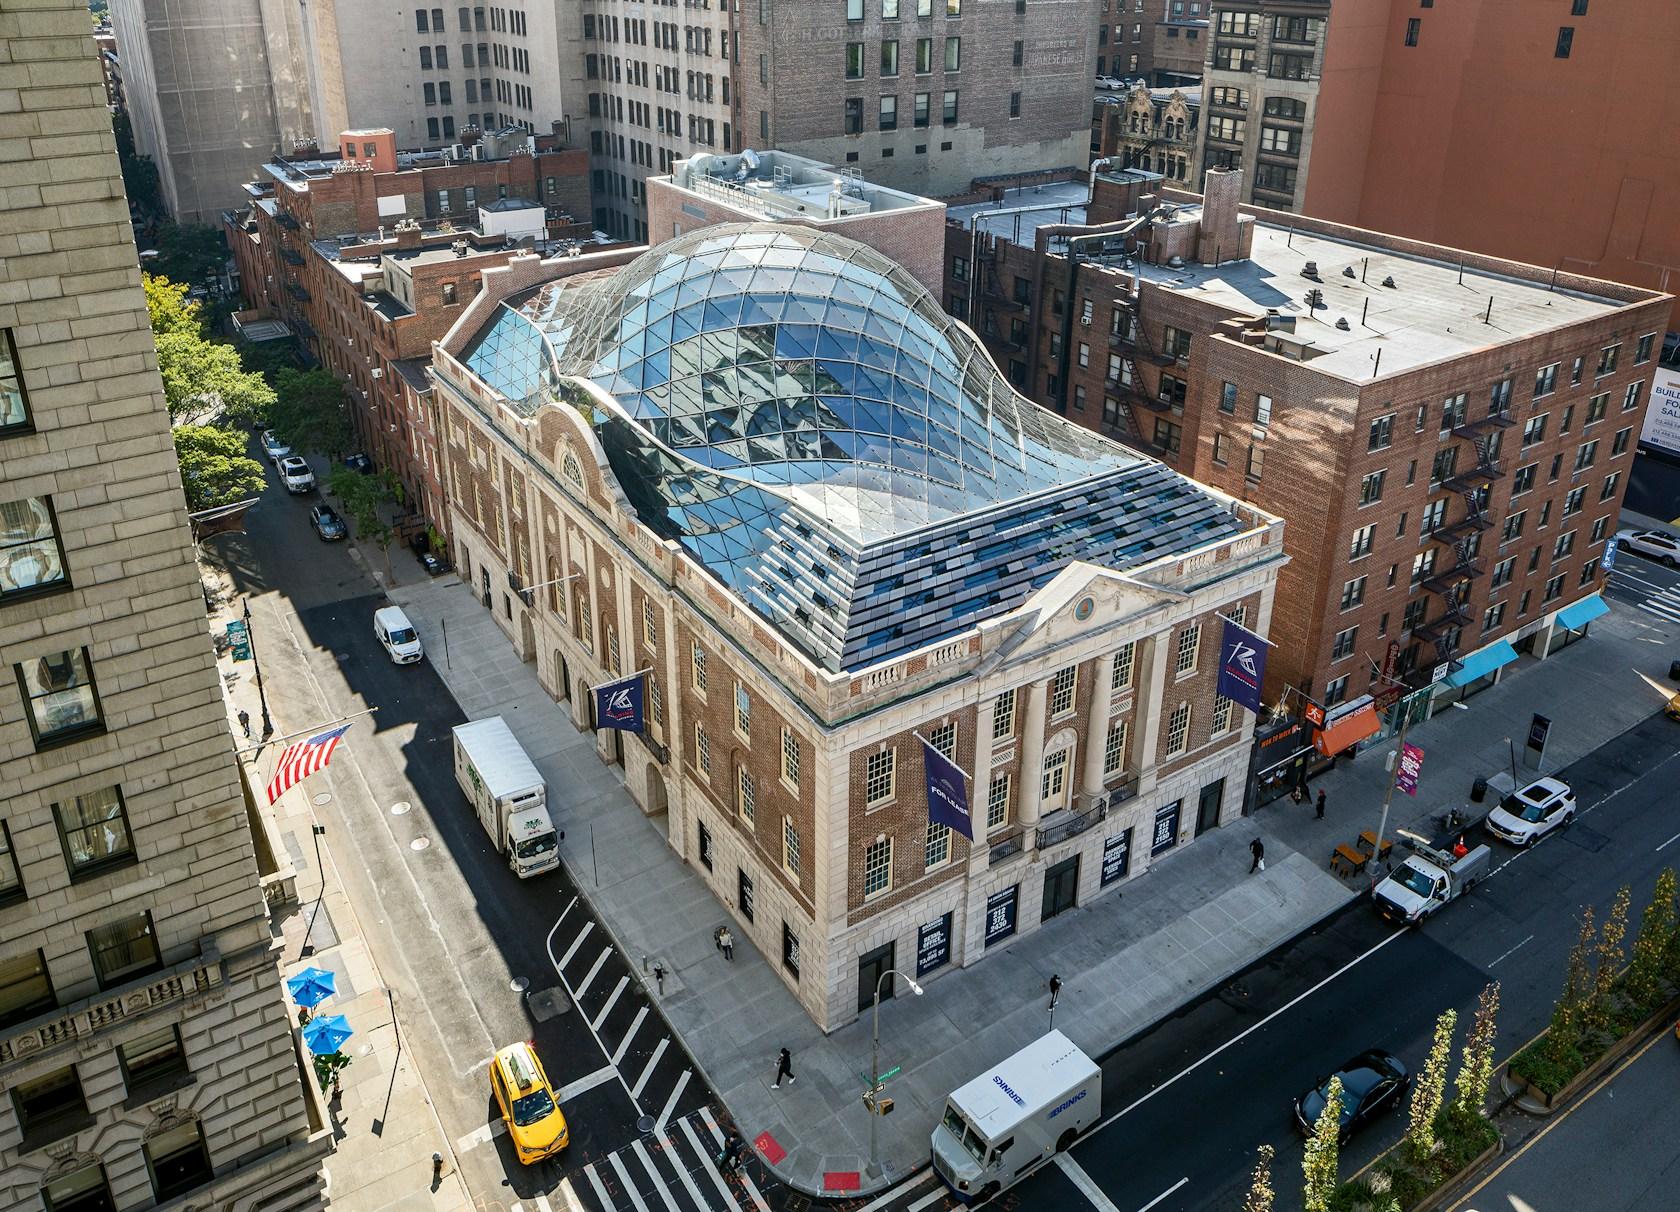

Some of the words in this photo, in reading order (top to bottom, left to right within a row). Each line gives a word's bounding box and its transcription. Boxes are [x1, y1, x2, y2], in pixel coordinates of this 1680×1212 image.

[1665, 399, 1680, 409] FO
[1661, 407, 1680, 418] SAL
[931, 786, 947, 801] FOR
[947, 797, 969, 816] LEASE
[993, 907, 1006, 918] 212
[992, 914, 1006, 925] 372
[992, 1075, 1024, 1106] BRINKS
[1050, 1089, 1087, 1118] BRINKS
